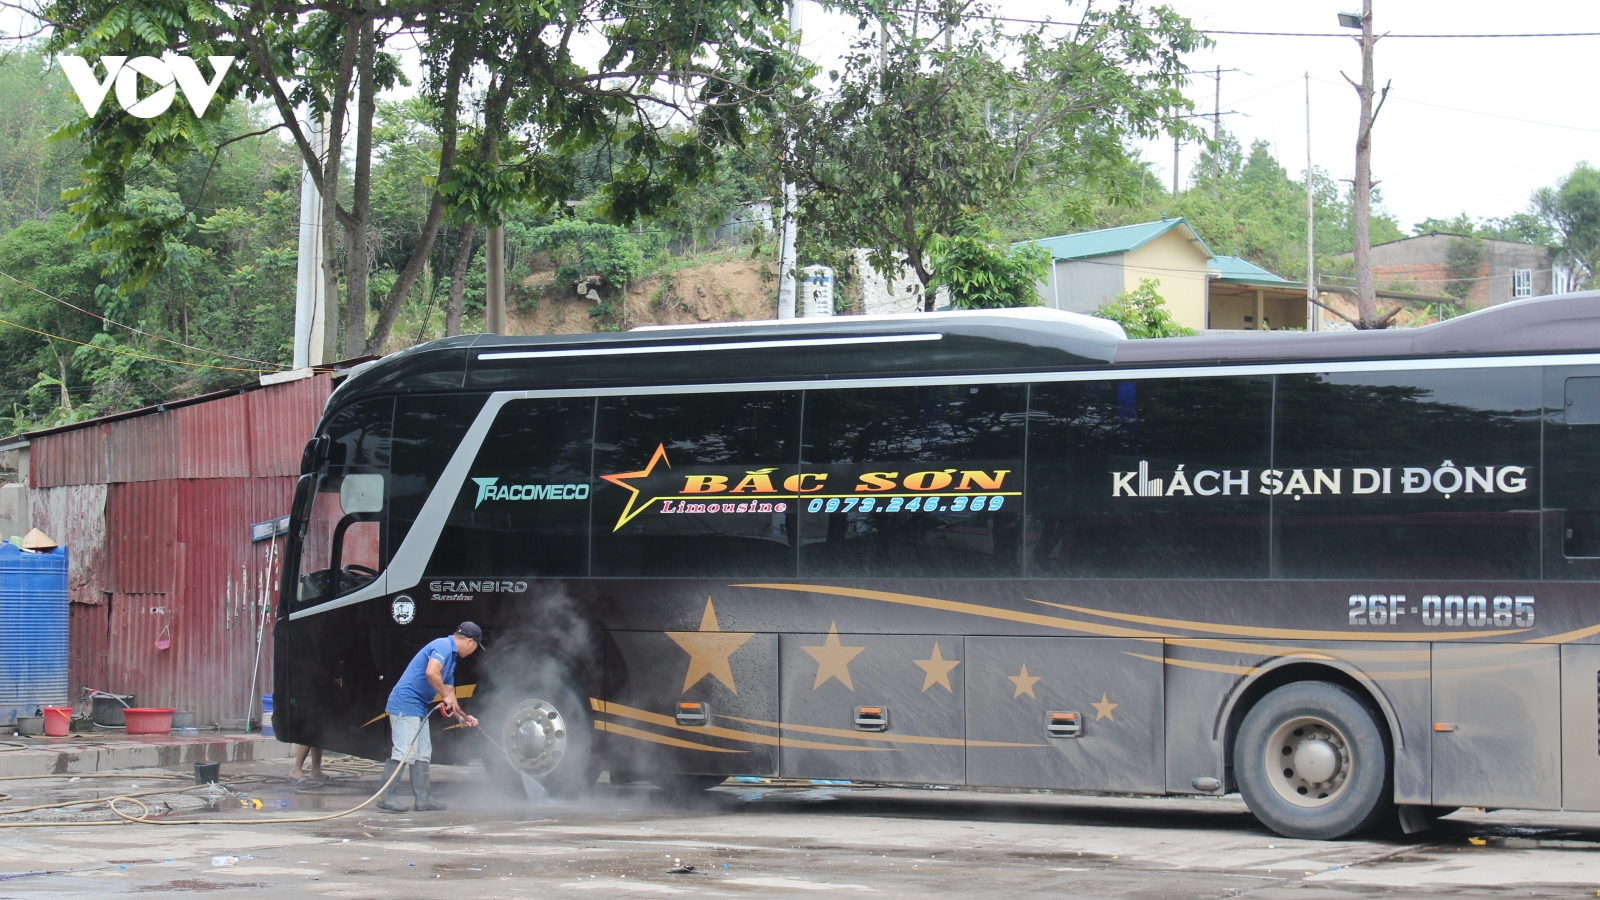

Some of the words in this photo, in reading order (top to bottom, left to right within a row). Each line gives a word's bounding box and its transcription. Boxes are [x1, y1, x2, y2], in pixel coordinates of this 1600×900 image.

[471, 477, 590, 510] TRACOMECO
[679, 467, 828, 494] BẮC
[855, 468, 1011, 492] SƠN
[1259, 469, 1341, 501] SẠN
[1352, 468, 1391, 493] DI
[1400, 460, 1528, 499] ĐỘNG
[660, 501, 786, 513] Limousine
[807, 496, 1005, 513] 0973.246.369
[429, 580, 528, 593] GRANBIRD
[1349, 595, 1534, 627] 26F-000.85
